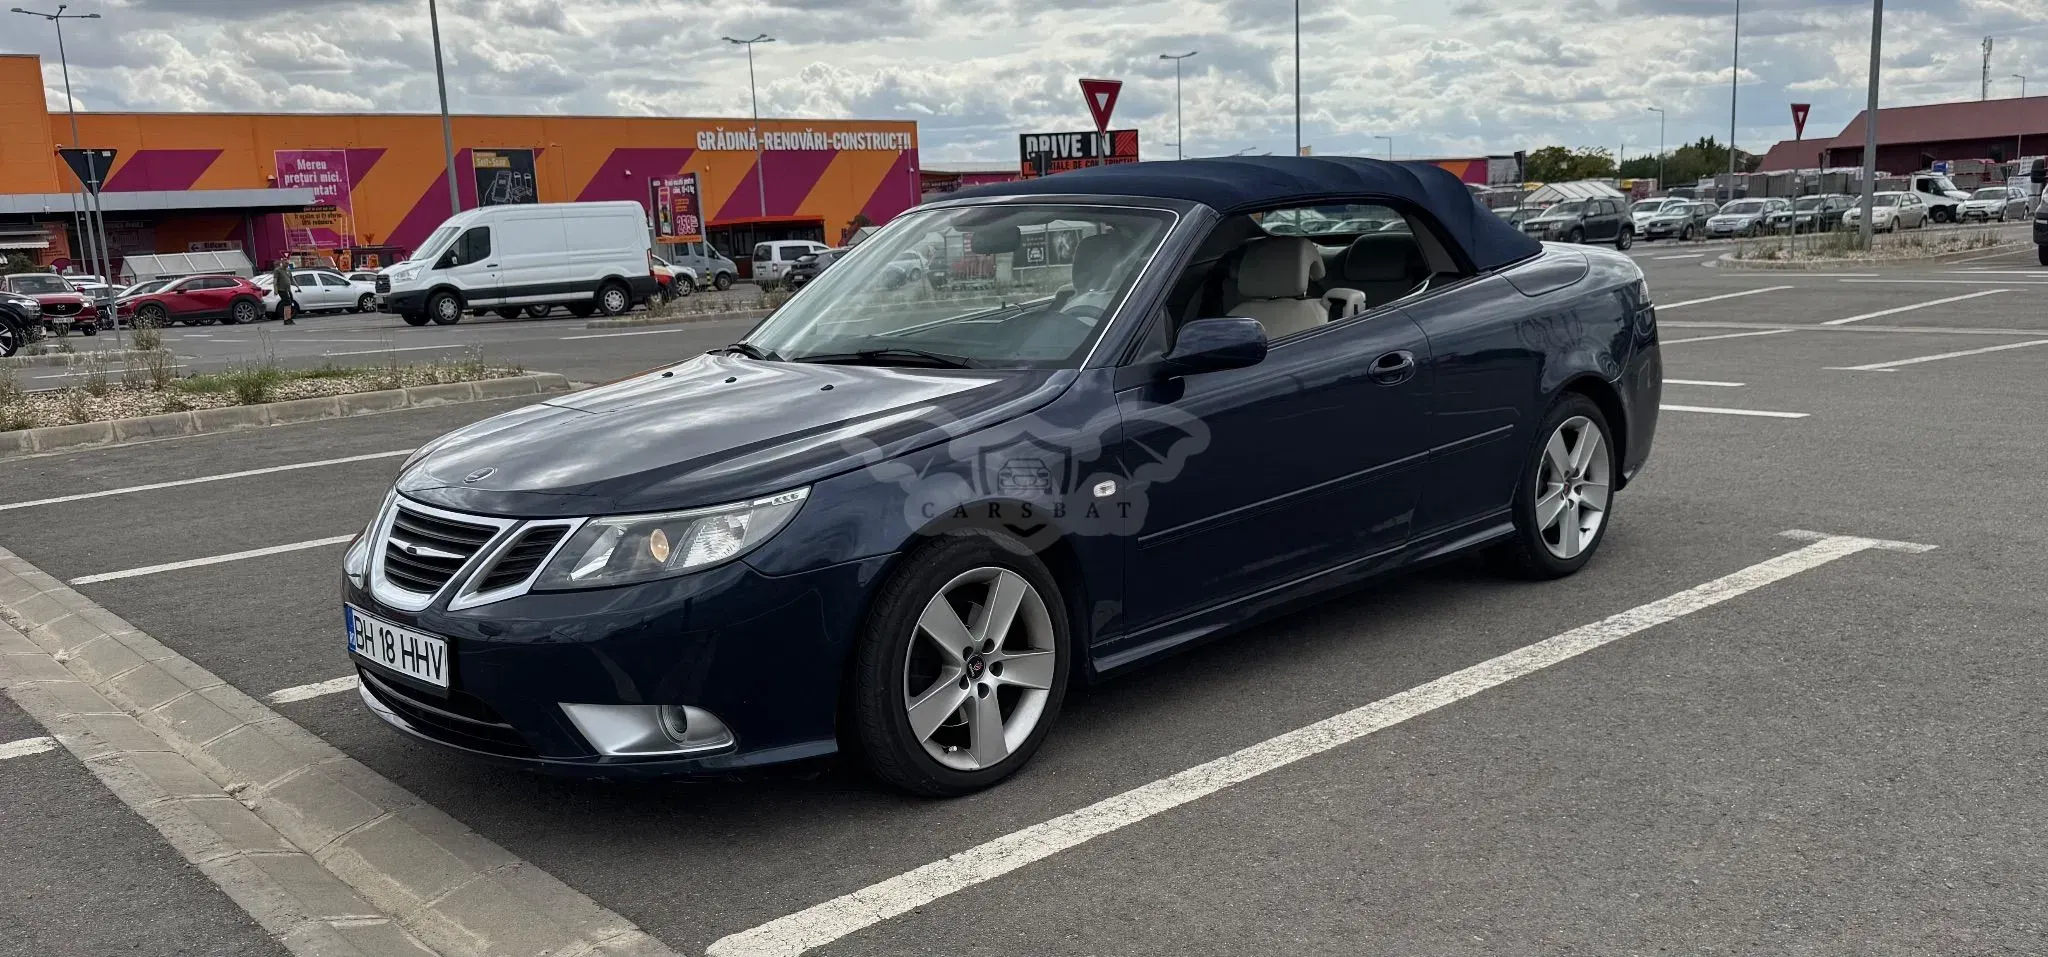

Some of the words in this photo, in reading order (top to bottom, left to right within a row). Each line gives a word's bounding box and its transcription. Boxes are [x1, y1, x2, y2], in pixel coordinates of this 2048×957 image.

[1026, 134, 1083, 159] DRIVE
[1090, 133, 1111, 156] IN
[297, 159, 327, 170] Mereu
[284, 172, 317, 186] prețuri
[320, 171, 342, 183] mici.
[354, 615, 375, 657] BH
[379, 627, 395, 664] 18
[400, 634, 443, 680] HHV
